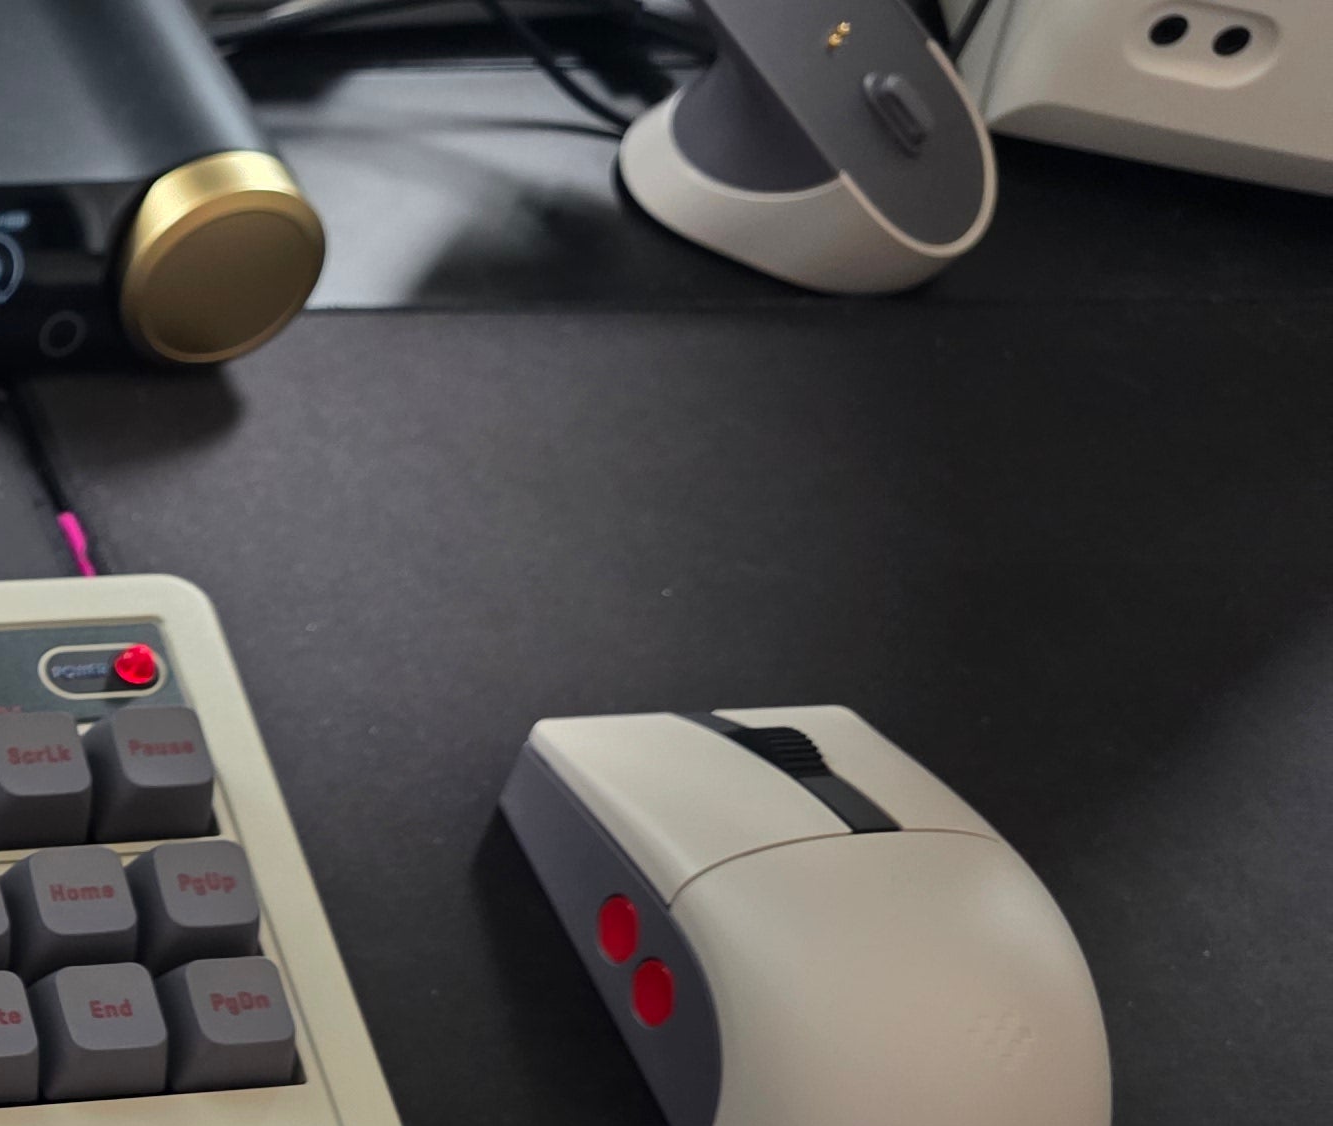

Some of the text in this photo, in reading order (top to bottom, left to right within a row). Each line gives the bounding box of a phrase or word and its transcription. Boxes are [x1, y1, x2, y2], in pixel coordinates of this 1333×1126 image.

[6, 745, 71, 765] ScrLk
[128, 739, 195, 756] Pause
[49, 884, 116, 901] Home
[177, 872, 237, 894] PgUp
[89, 999, 134, 1019] End
[210, 991, 270, 1015] PgDn
